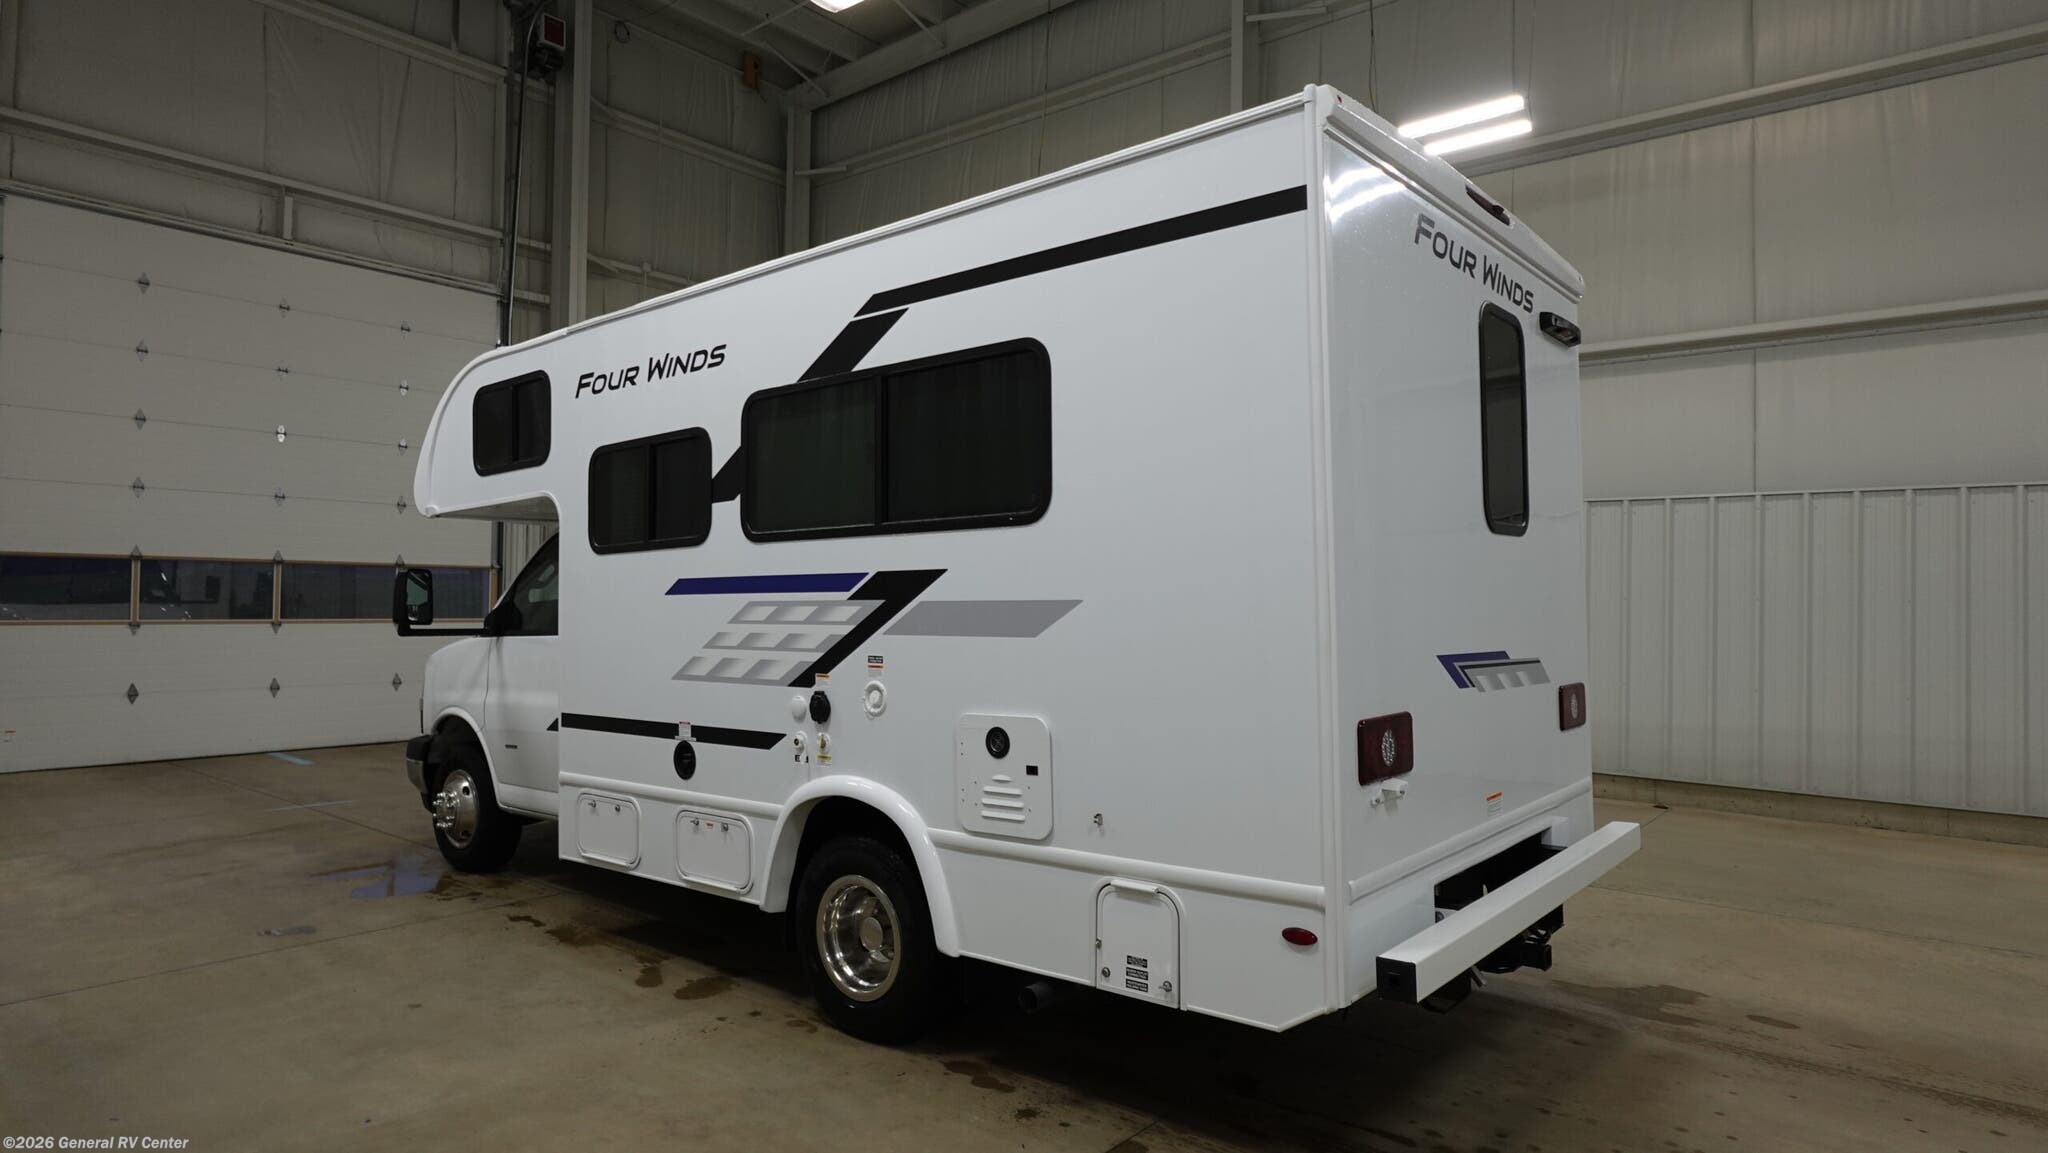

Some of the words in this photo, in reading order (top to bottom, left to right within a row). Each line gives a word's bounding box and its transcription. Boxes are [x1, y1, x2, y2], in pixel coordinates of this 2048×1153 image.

[1414, 213, 1477, 279] FOUR
[1483, 255, 1534, 313] WINDS
[575, 366, 640, 399] FOUR
[647, 344, 727, 382] WINDS
